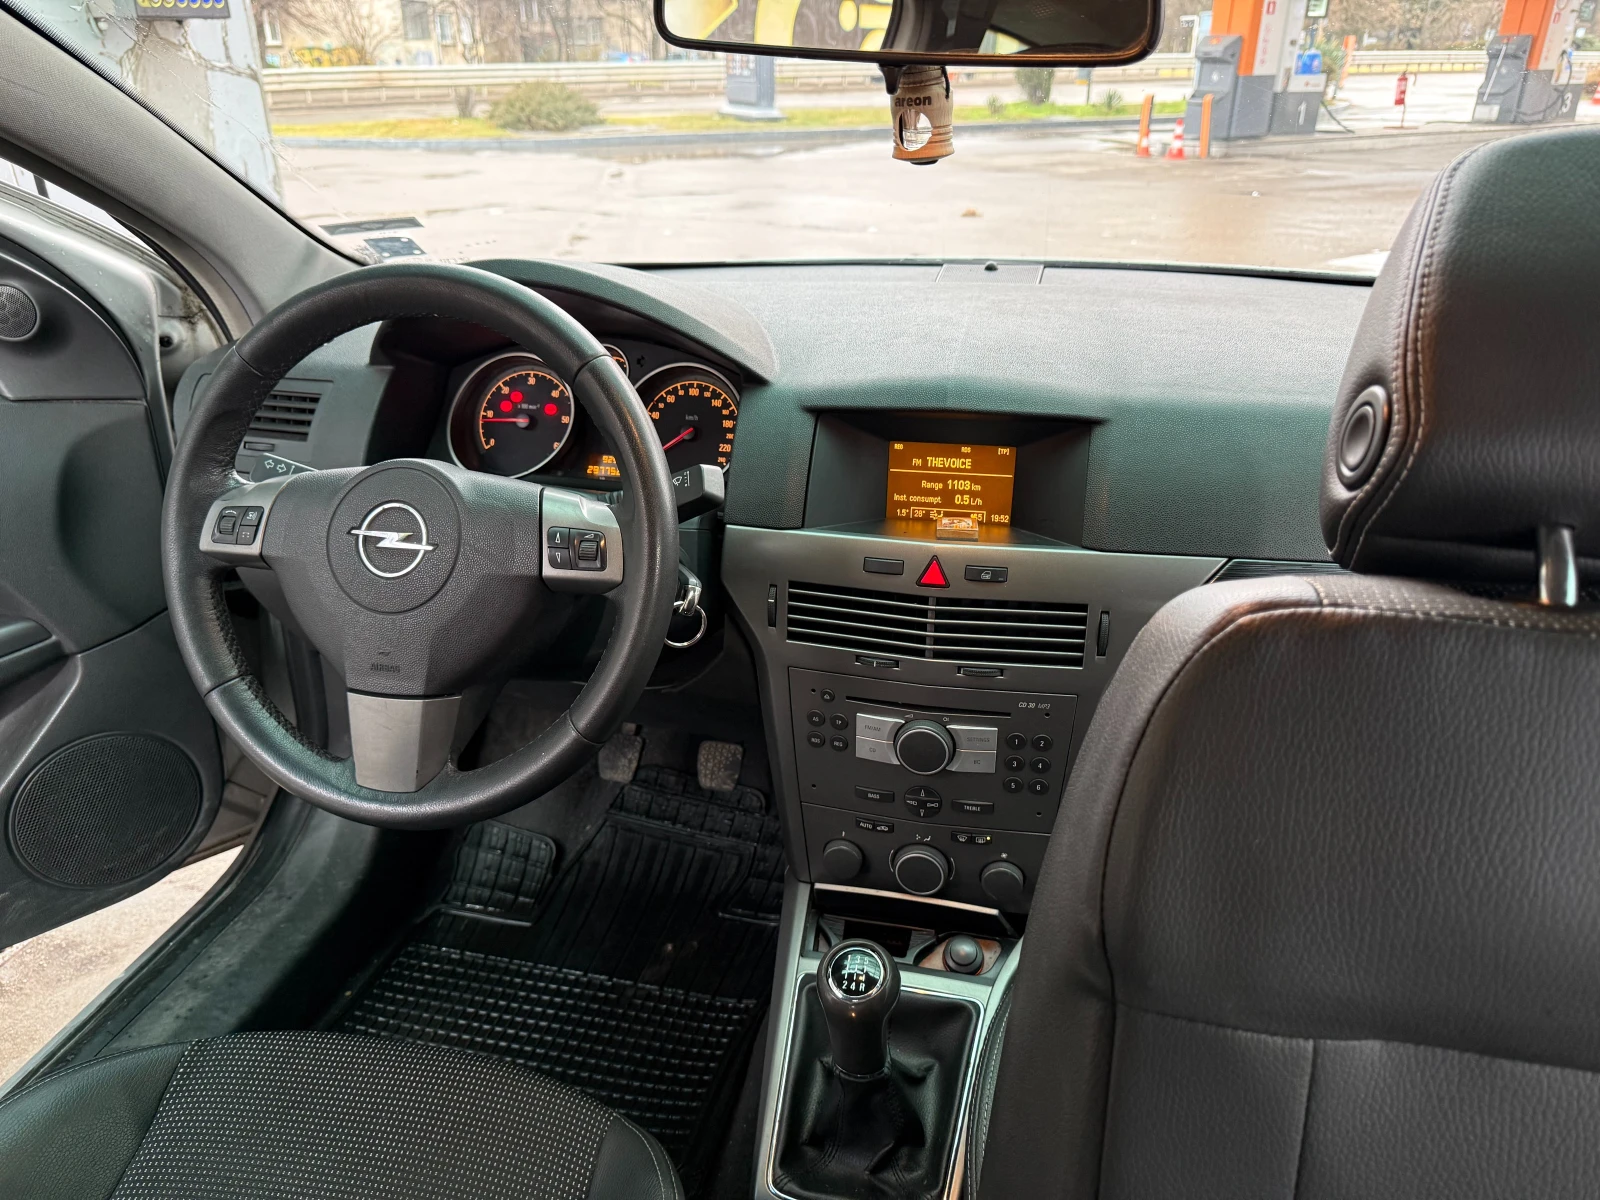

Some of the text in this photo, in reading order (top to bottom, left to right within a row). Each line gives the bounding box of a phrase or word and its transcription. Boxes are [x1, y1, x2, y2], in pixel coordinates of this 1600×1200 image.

[894, 95, 932, 108] areon
[1561, 92, 1573, 113] 3
[527, 377, 536, 385] 30
[501, 386, 510, 394] 20
[551, 390, 560, 399] 40
[689, 388, 700, 396] 100
[666, 395, 676, 403] 60
[711, 399, 722, 408] 140
[486, 410, 494, 418] 10
[651, 411, 660, 420] 40
[561, 415, 570, 424] 50
[722, 420, 734, 429] 180
[489, 438, 496, 446] 0
[718, 443, 732, 453] 220
[912, 456, 972, 469] FM THEVOICE
[921, 479, 981, 491] Range 1103 km
[893, 493, 908, 502] Inst.
[954, 494, 970, 505] 0.5
[913, 509, 926, 518] 28°
[990, 514, 1010, 523] 19:52
[1018, 701, 1027, 709] CD
[963, 804, 981, 812] TREBLE
[859, 821, 873, 829] AUTO
[841, 980, 848, 990] 2
[849, 981, 856, 991] 4
[859, 982, 866, 992] R
